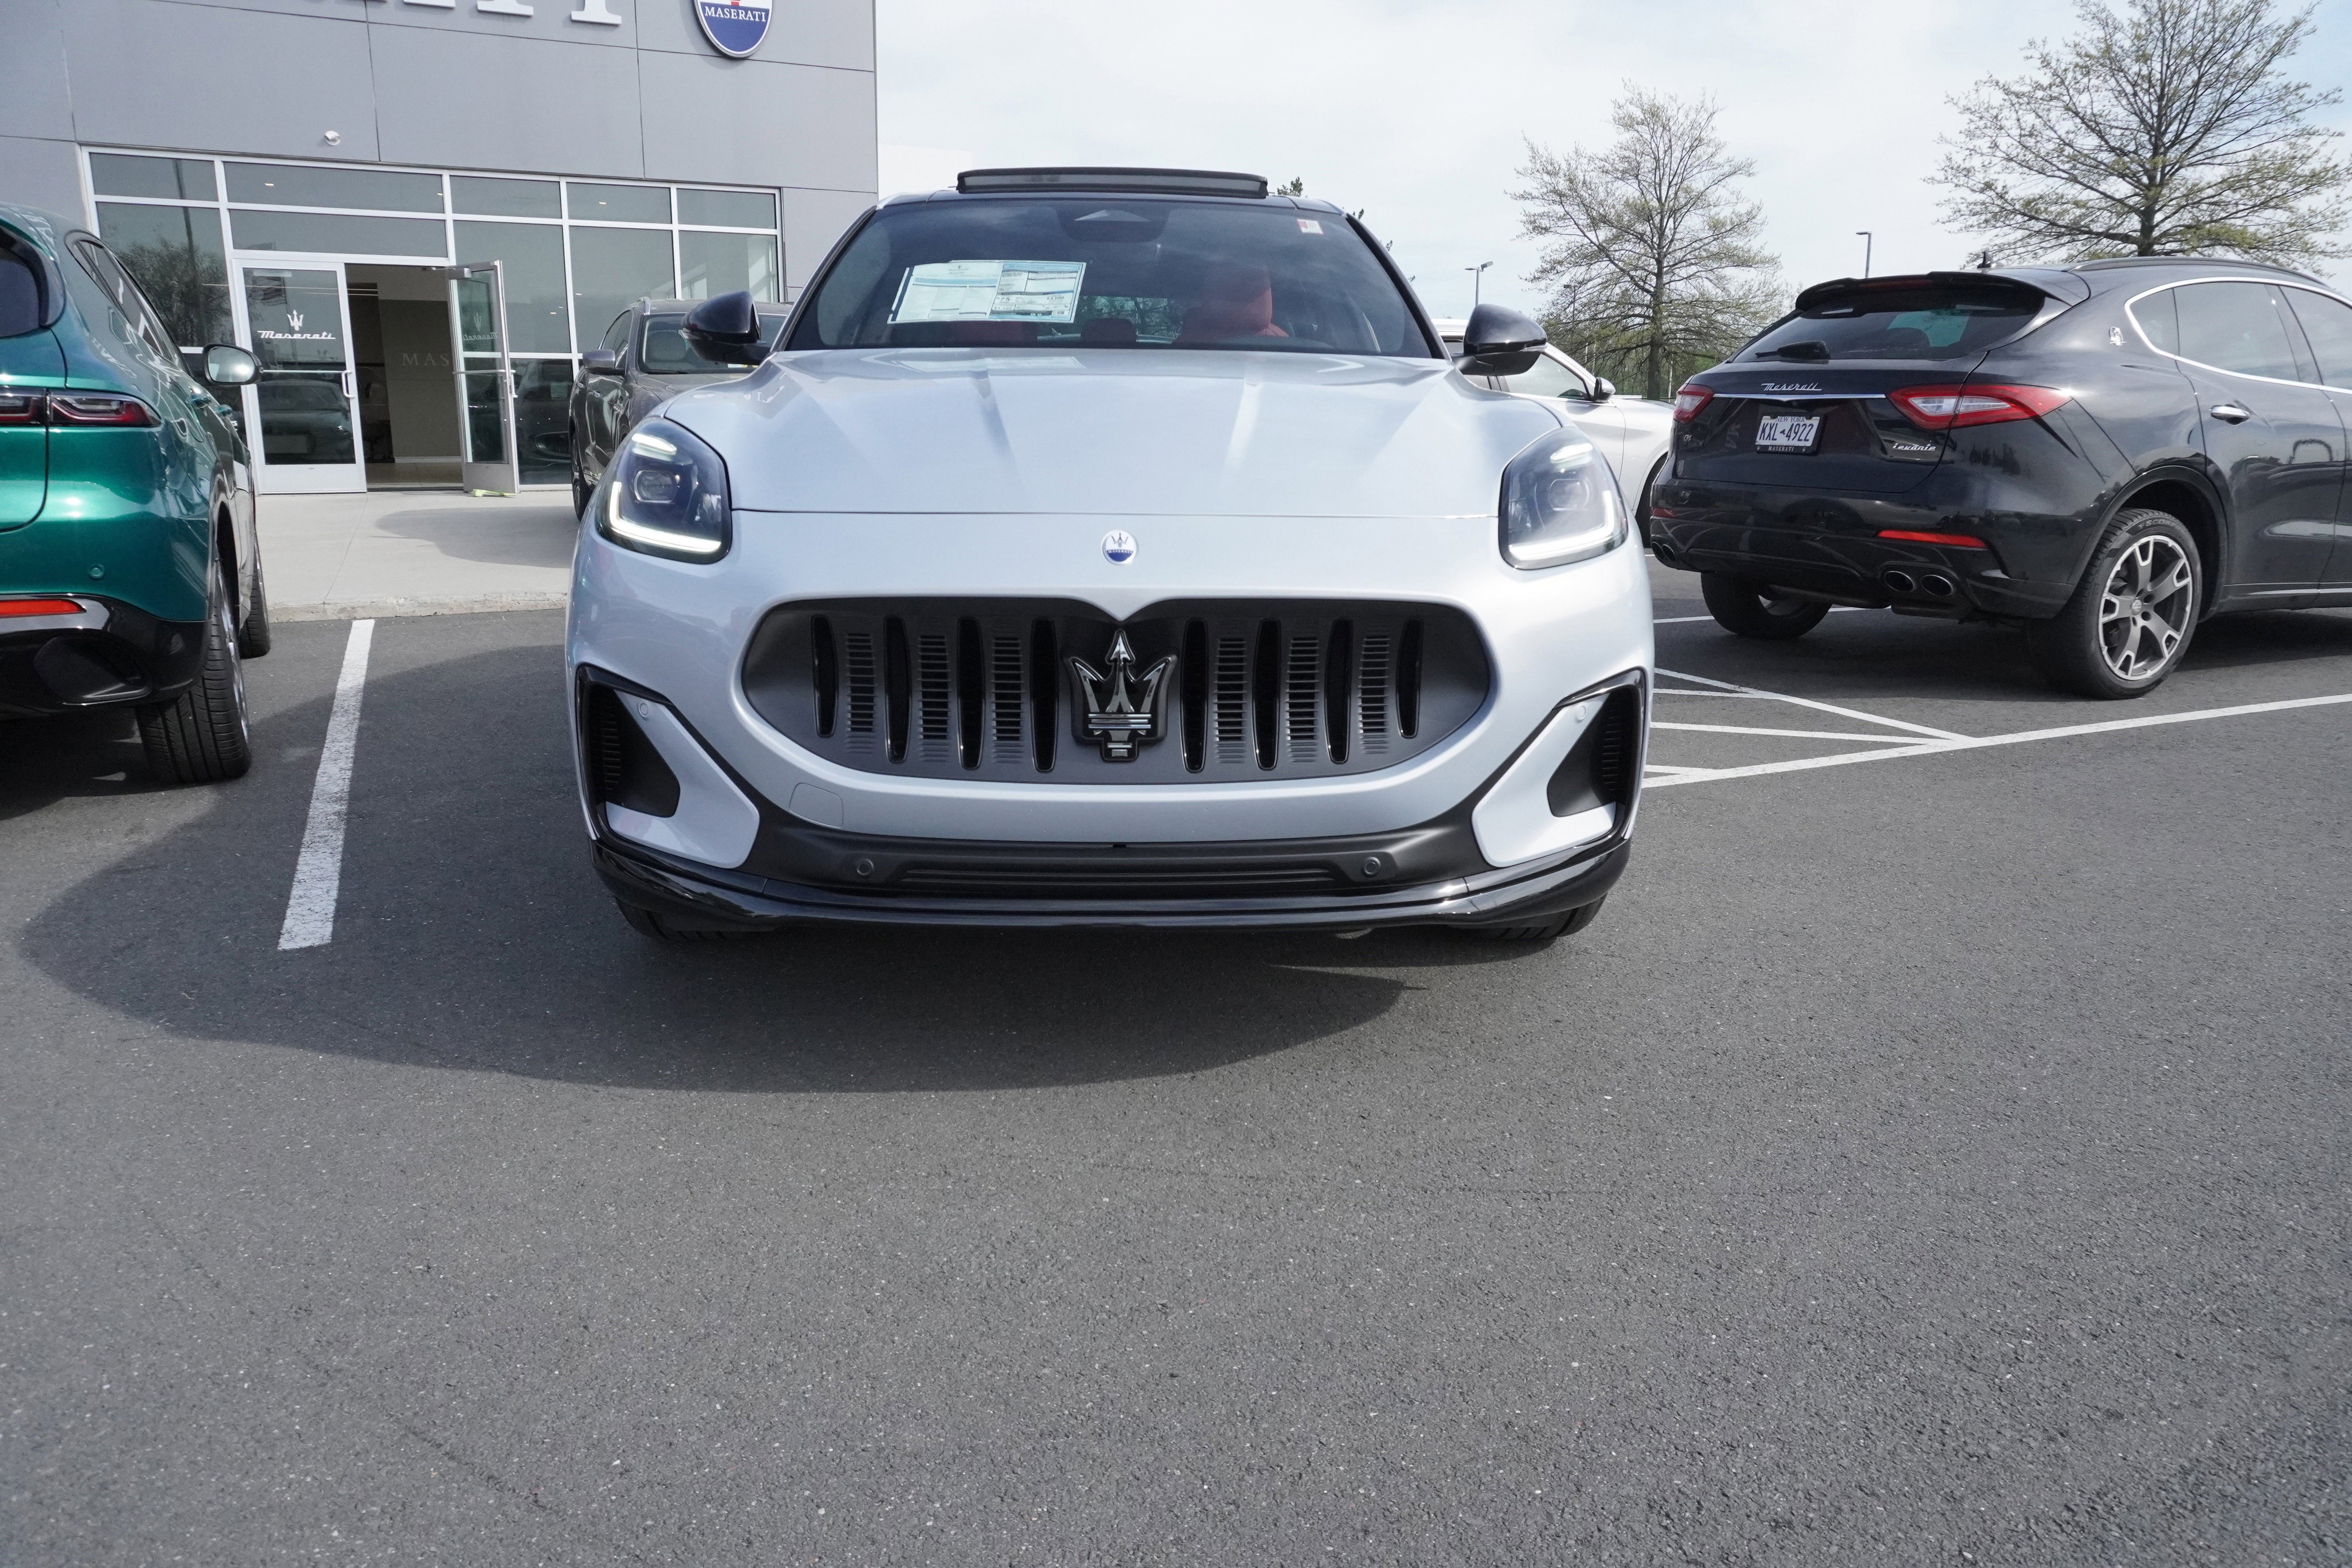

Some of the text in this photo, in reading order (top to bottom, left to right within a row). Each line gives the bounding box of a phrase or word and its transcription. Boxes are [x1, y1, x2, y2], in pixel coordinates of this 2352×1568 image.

[704, 6, 766, 22] MASERATI
[257, 330, 336, 339] Maserati
[1761, 383, 1822, 391] Maserati
[1759, 422, 1814, 441] KXL 4922
